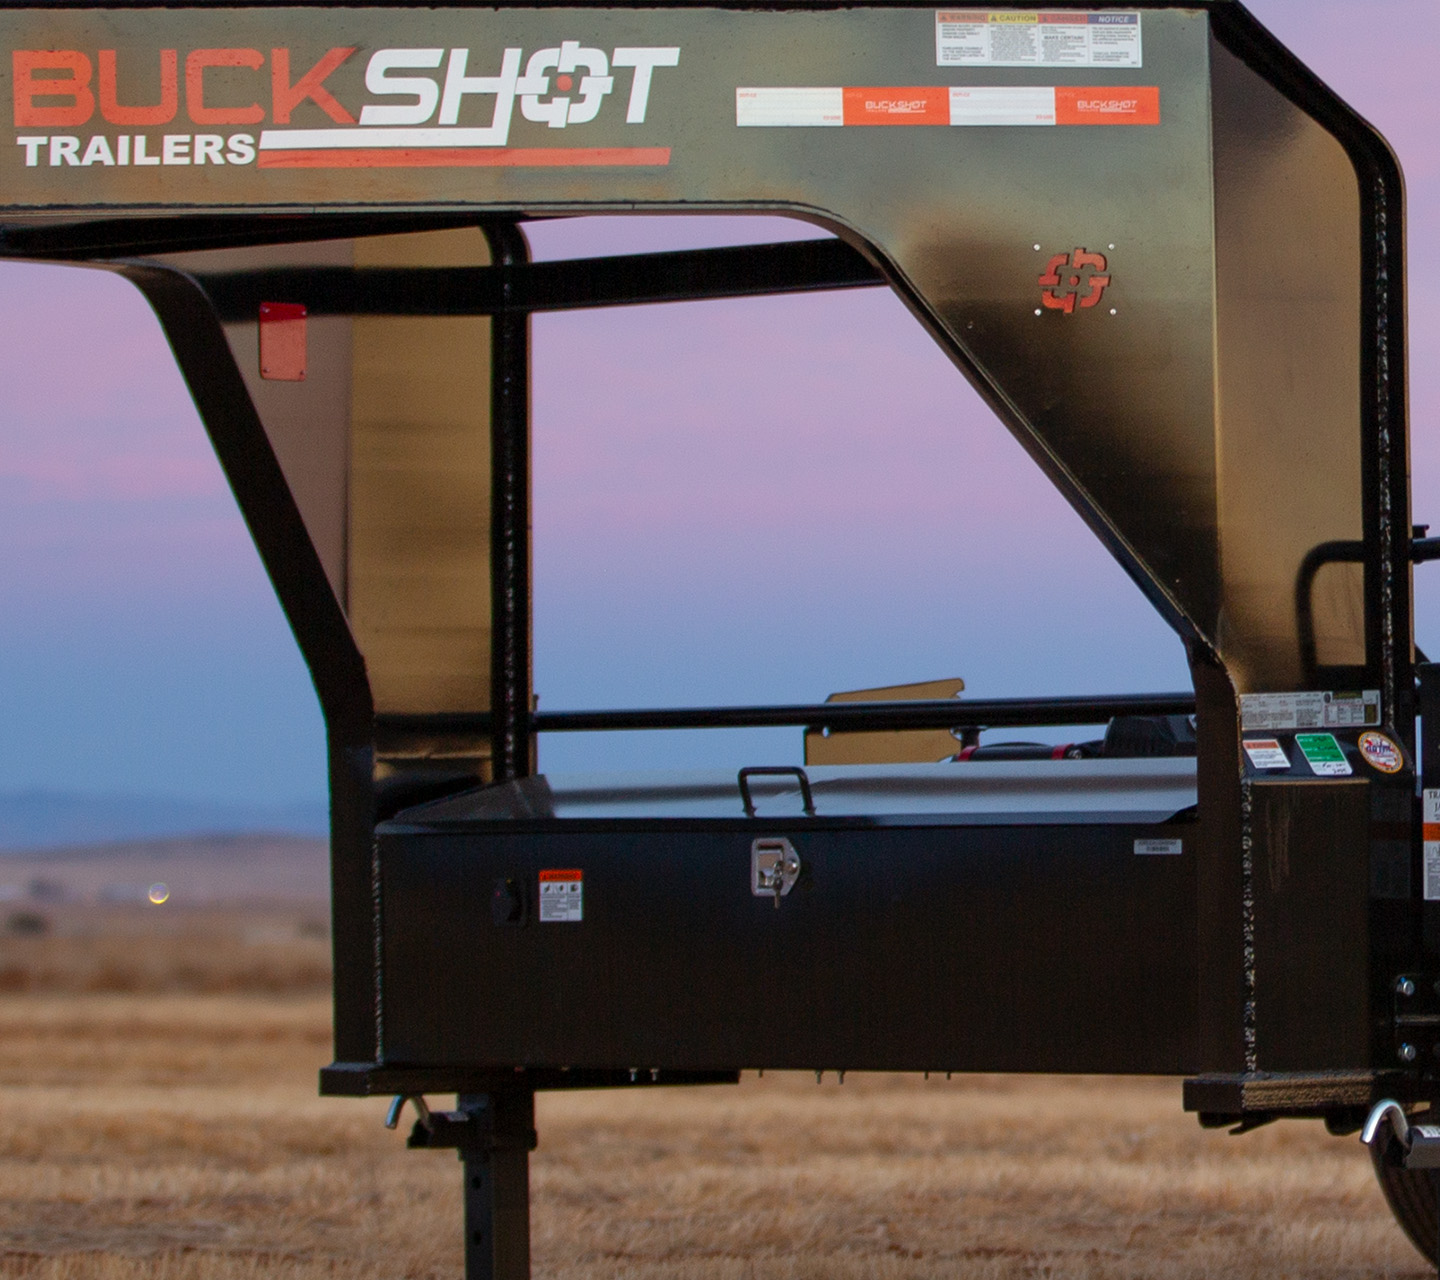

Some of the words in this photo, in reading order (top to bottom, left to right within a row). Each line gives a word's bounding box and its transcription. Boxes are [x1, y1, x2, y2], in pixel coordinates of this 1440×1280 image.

[999, 14, 1037, 23] CAUTION
[1098, 15, 1130, 23] NOTICE
[11, 40, 681, 130] BUCKSHOT
[864, 100, 927, 110] BUCKSHOT
[1077, 99, 1138, 110] BUCKSHOT
[16, 134, 256, 167] TRAILERS
